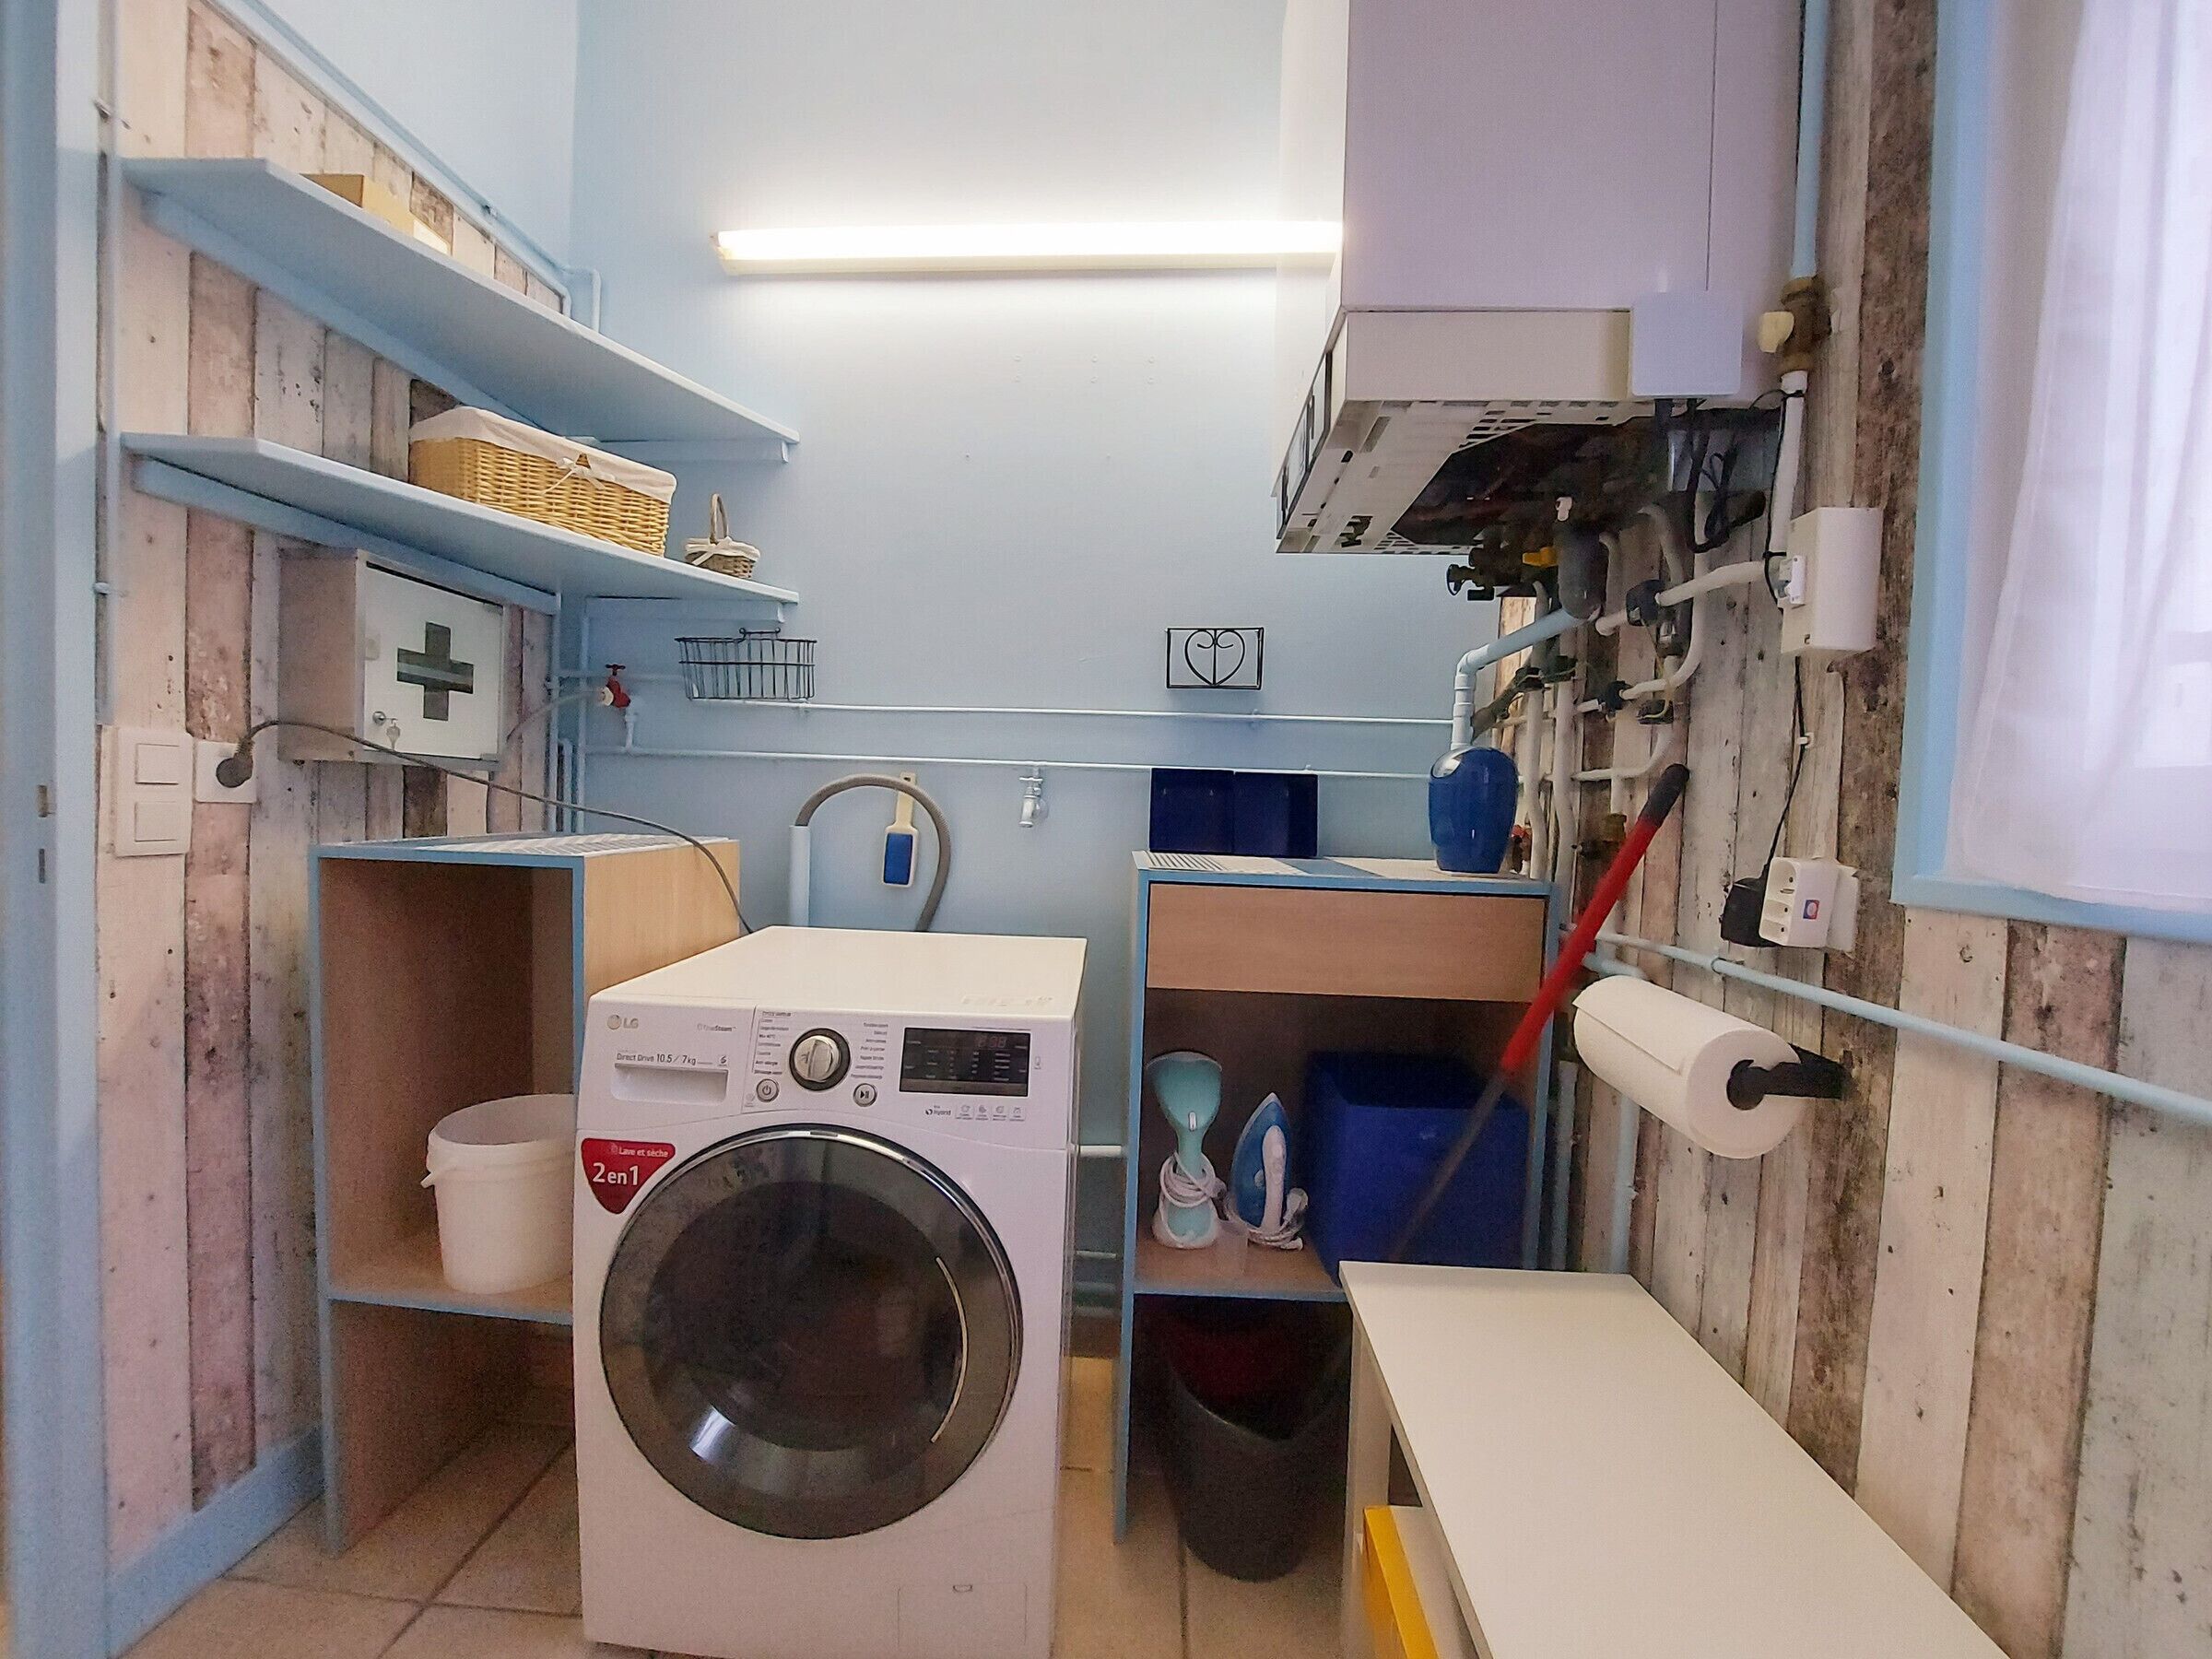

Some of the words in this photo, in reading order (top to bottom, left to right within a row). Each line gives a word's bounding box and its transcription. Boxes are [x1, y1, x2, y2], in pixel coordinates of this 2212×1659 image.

[623, 1017, 640, 1030] LG
[616, 1053, 636, 1062] Direct
[637, 1053, 654, 1062] Drive
[618, 1146, 636, 1156] Lave
[636, 1148, 646, 1157] et
